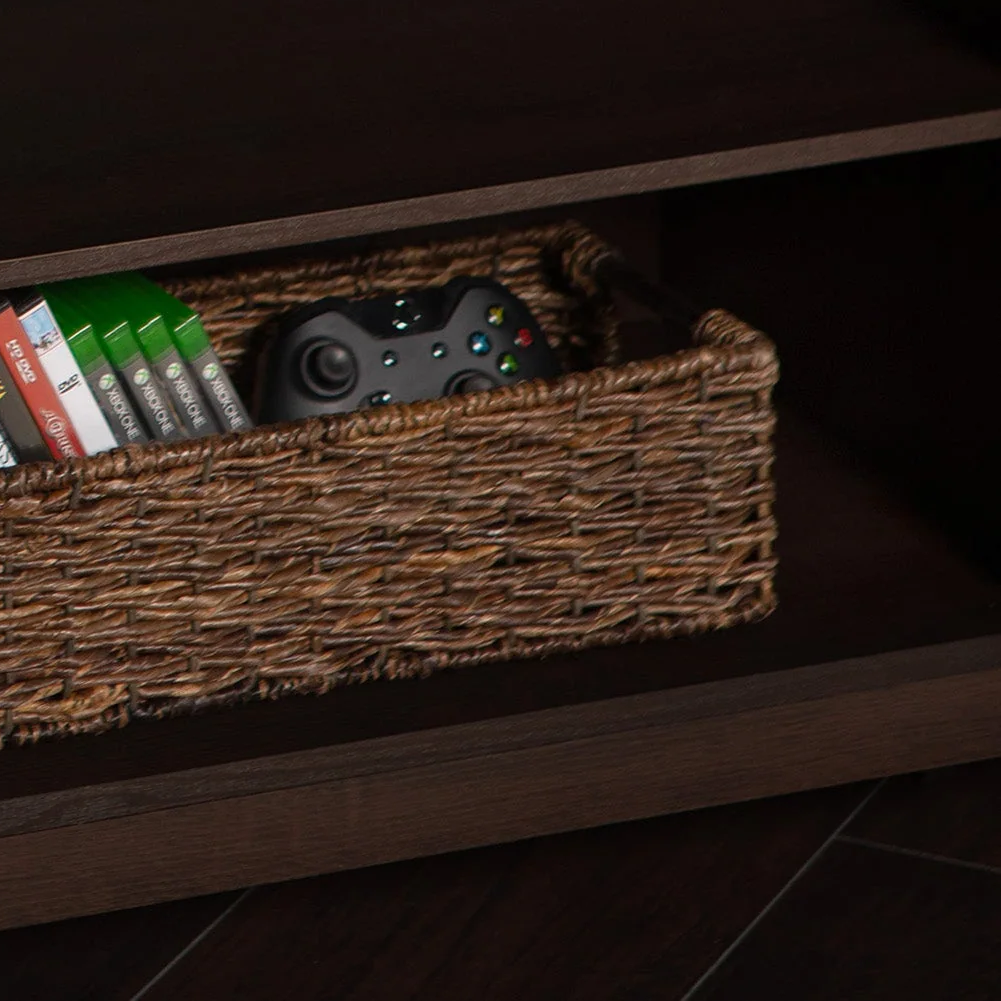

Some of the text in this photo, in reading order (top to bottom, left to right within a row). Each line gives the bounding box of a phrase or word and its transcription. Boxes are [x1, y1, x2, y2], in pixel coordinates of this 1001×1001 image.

[5, 338, 38, 385] HD DVD
[106, 388, 142, 441] XBOX ONE
[141, 384, 176, 437] XBOX ONE
[173, 376, 208, 430] XBOX ONE
[210, 376, 246, 431] XBOX ONE
